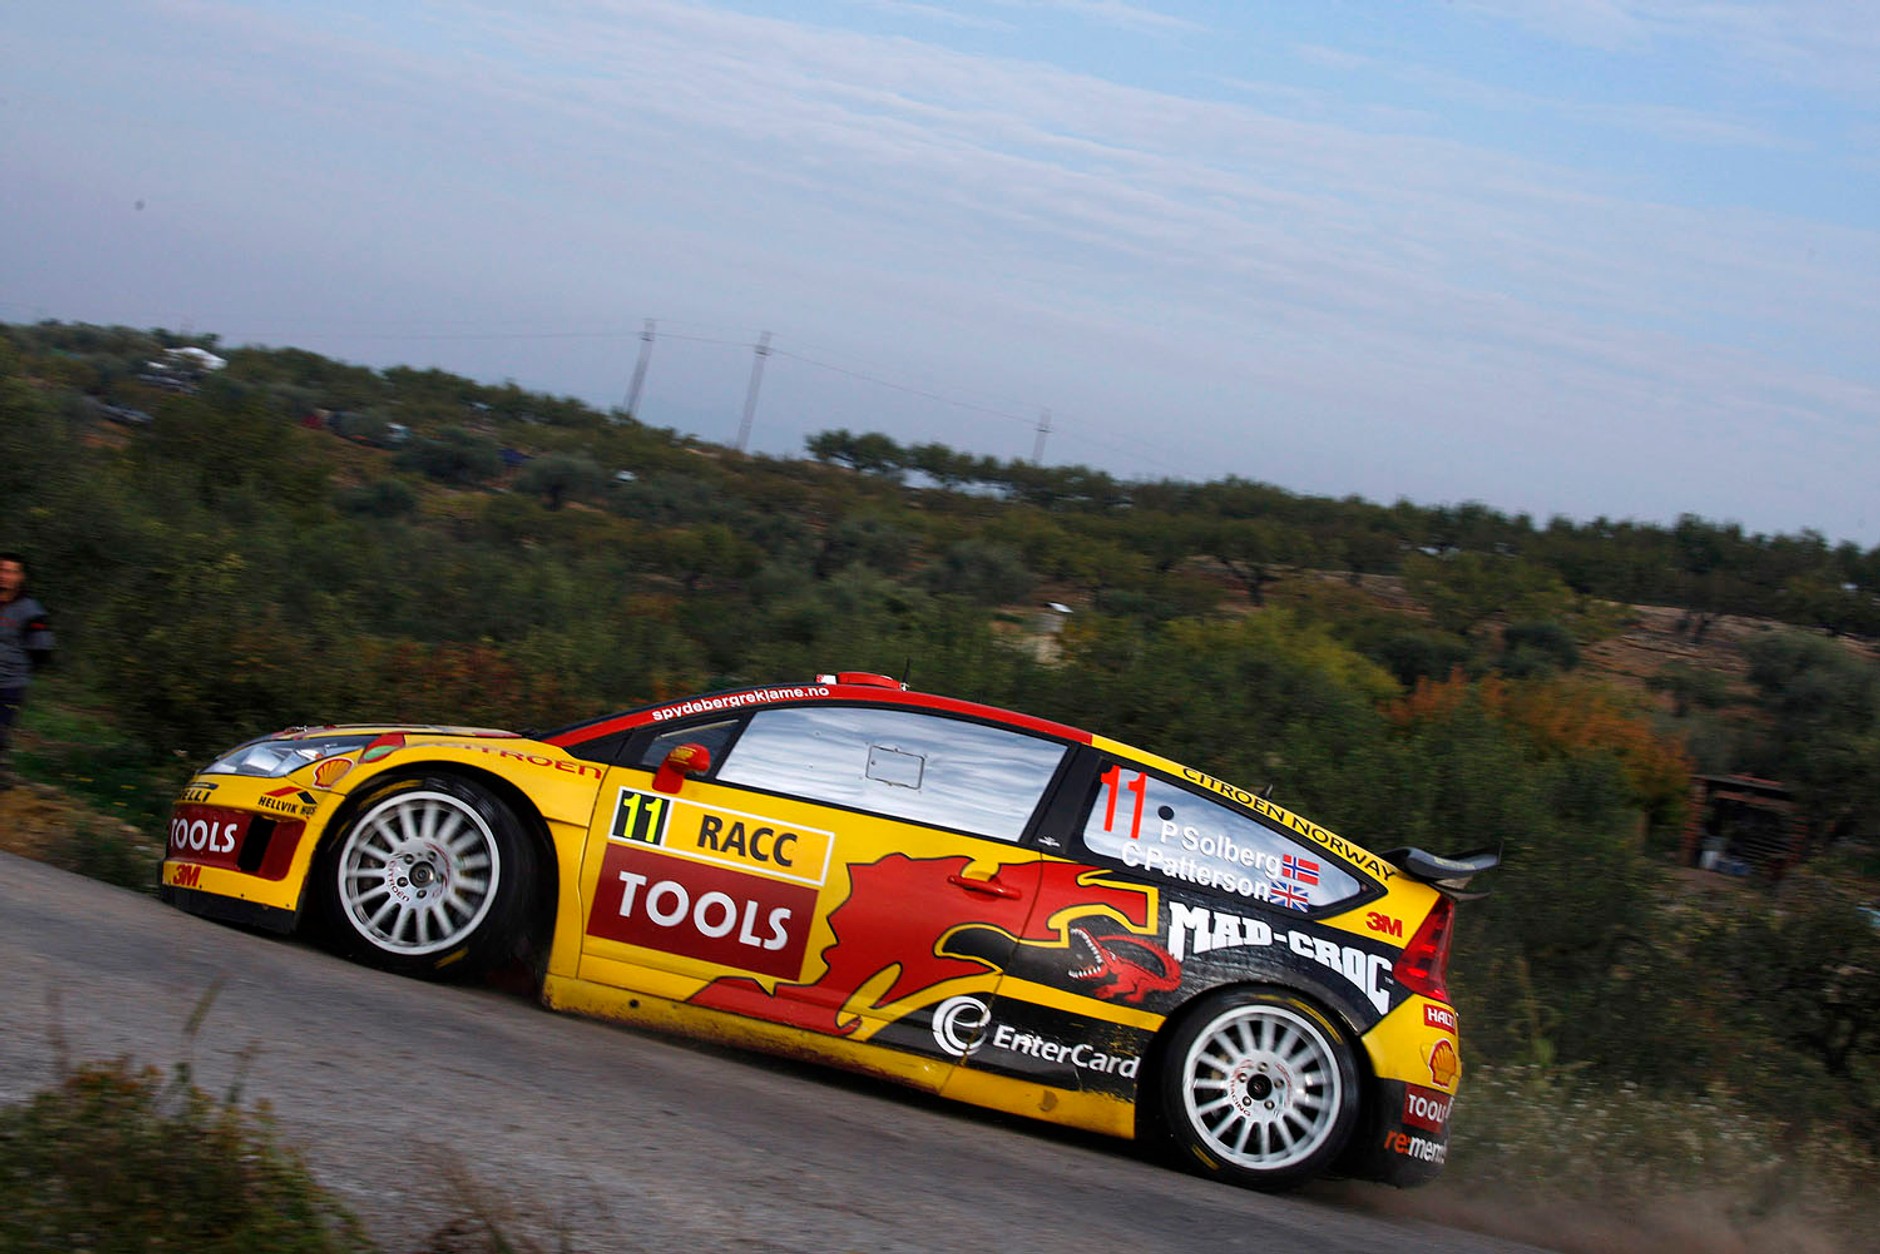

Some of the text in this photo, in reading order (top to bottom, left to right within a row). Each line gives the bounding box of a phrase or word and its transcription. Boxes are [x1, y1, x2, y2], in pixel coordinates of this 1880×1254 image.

[652, 686, 830, 721] spydebergreklame.no
[258, 796, 299, 814] HELLVIK
[622, 793, 664, 844] 11
[1101, 765, 1149, 840] 11
[170, 818, 238, 854] TOOLS
[697, 814, 798, 867] RACC
[1160, 820, 1281, 880] P Solberg
[1292, 815, 1396, 881] NORWAY
[173, 863, 201, 888] 3M
[1121, 841, 1271, 901] C Patterson
[618, 870, 792, 951] TOOLS
[1366, 911, 1402, 938] 3M
[1166, 901, 1394, 1016] MAD-CROC
[992, 1024, 1142, 1079] EnterCard
